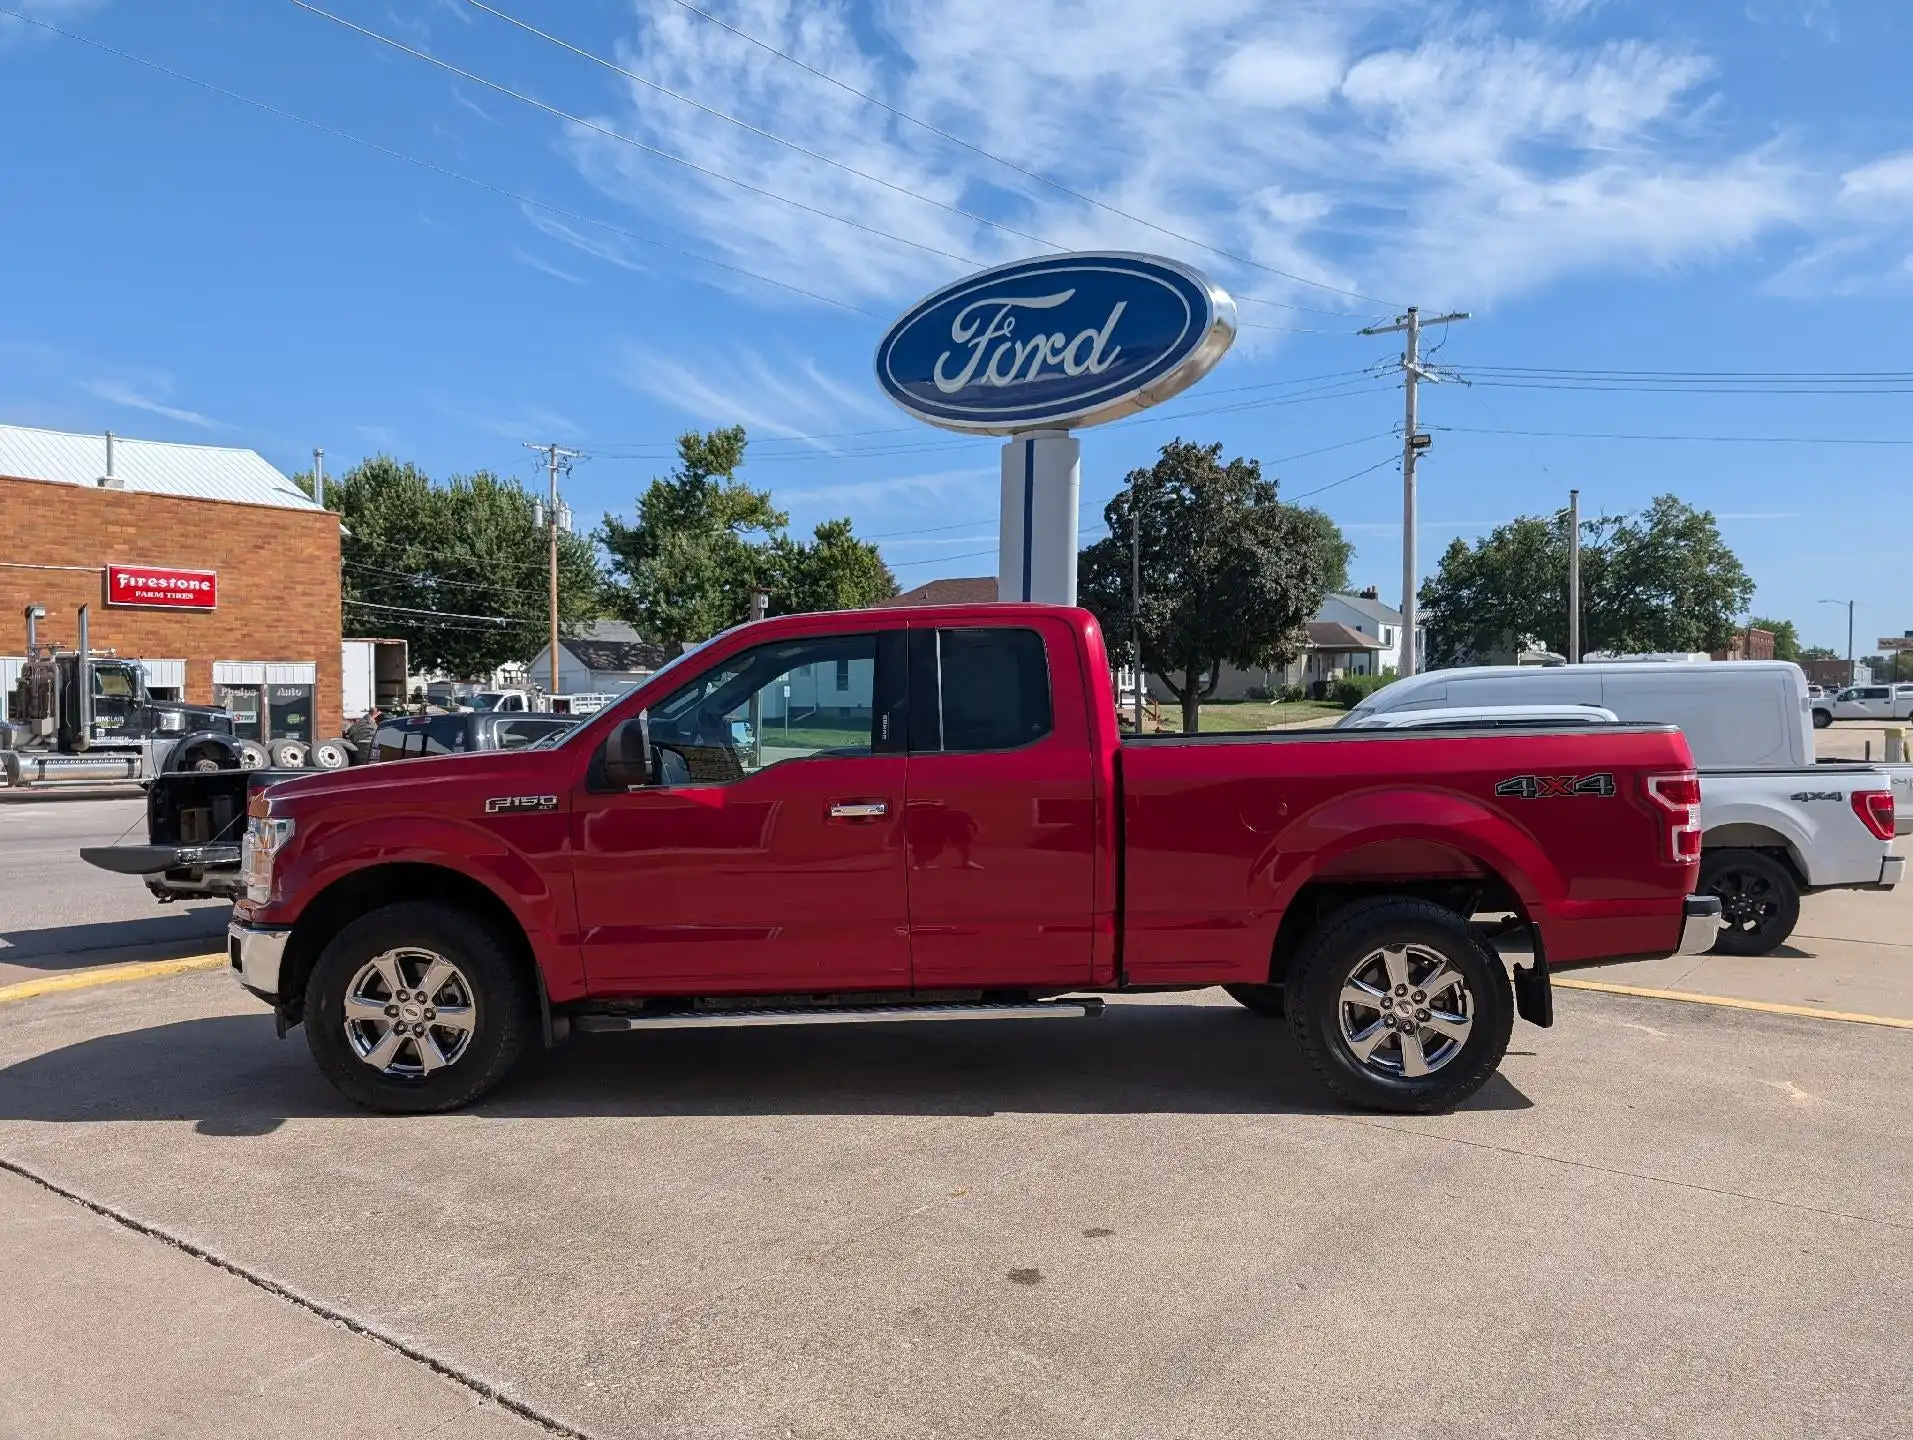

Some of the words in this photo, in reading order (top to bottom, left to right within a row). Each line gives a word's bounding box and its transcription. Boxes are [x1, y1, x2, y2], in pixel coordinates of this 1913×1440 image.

[933, 288, 1128, 394] Ford
[116, 573, 211, 591] Firestone
[135, 590, 164, 599] FARM
[166, 592, 194, 600] TIRES
[276, 687, 302, 697] Auto
